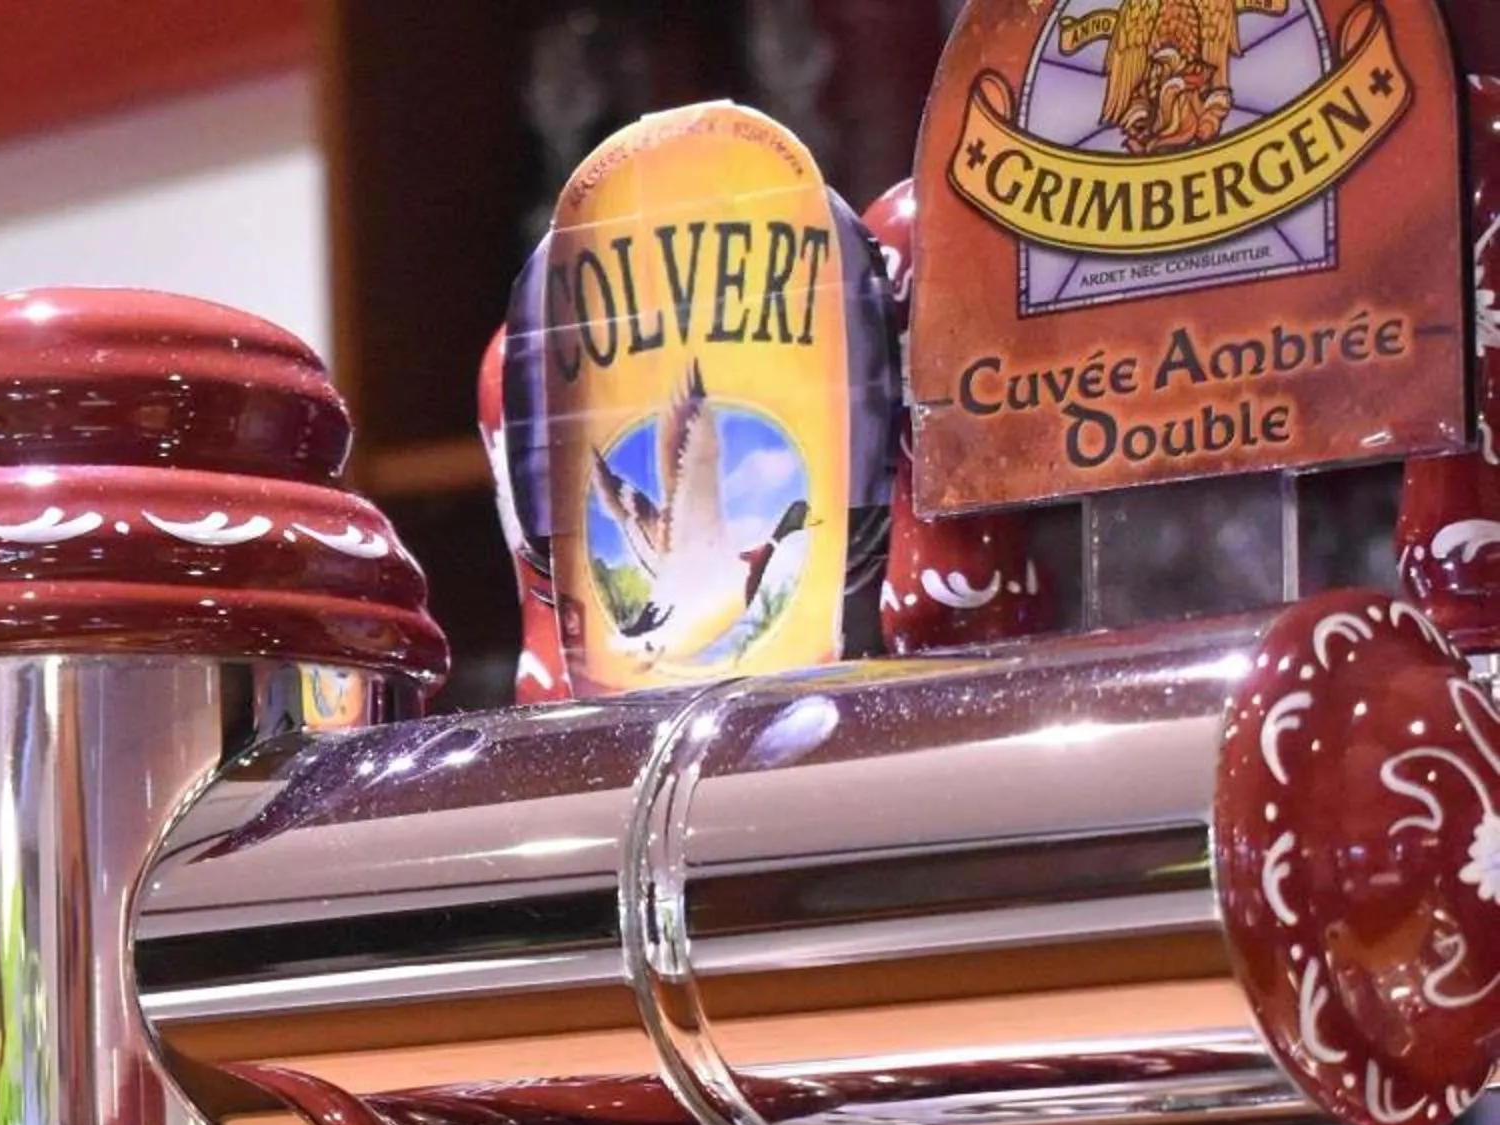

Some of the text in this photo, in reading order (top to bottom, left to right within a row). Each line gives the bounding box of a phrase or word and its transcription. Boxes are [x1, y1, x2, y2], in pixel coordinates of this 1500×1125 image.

[1070, 17, 1112, 44] ANNO
[986, 87, 1371, 231] GRIMBERGEN
[548, 222, 829, 381] COLVERT
[1130, 262, 1161, 280] NEC
[958, 310, 1405, 416] Cuvée Ambrée
[1062, 402, 1291, 469] Double
